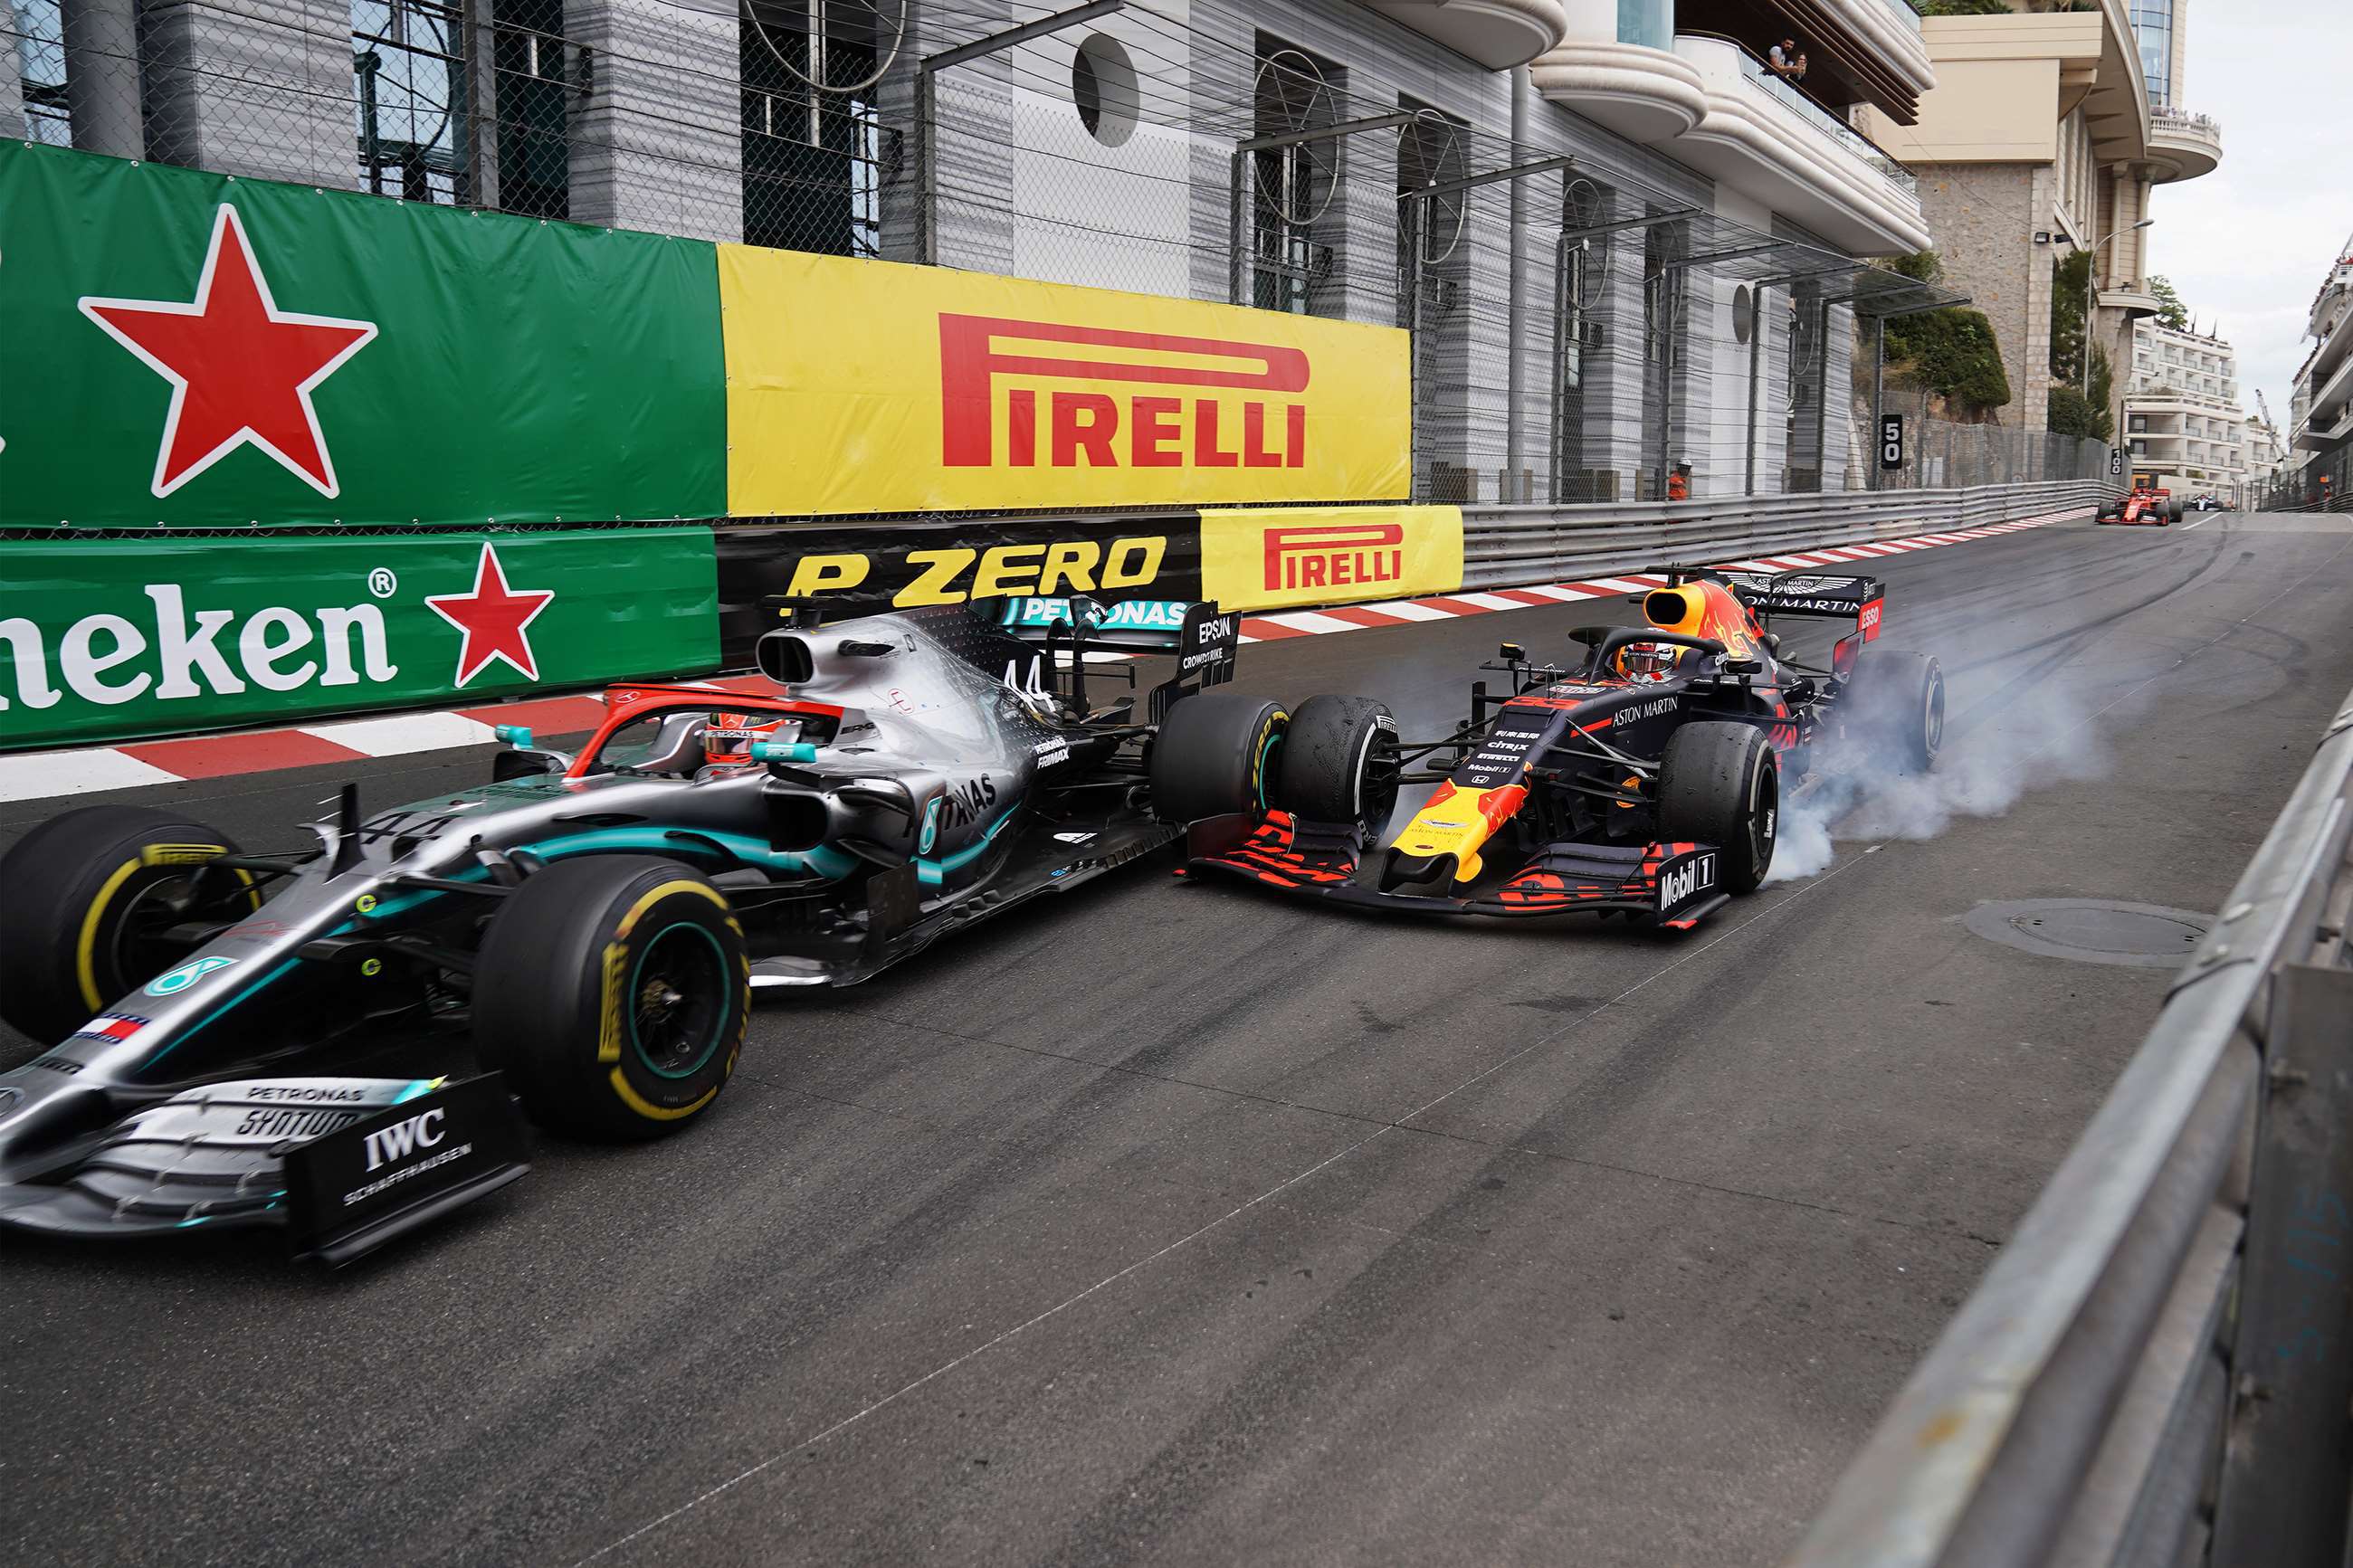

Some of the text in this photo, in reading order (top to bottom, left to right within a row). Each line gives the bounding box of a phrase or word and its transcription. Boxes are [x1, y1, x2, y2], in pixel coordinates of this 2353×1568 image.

[938, 312, 1310, 468] PIRELLI
[1885, 423, 1900, 461] 50
[2112, 450, 2120, 474] 100
[778, 536, 1167, 617] P ZERO
[1263, 524, 1403, 590] PIRELLI
[1198, 616, 1231, 644] EPSON
[1004, 654, 1056, 714] 44
[1613, 696, 1678, 727] ASTON MARTIN
[1037, 746, 1070, 769] FRIMAX
[1468, 764, 1499, 773] Mobil
[1661, 859, 1696, 911] Mobil
[246, 1086, 365, 1102] PETRONAS
[363, 1107, 445, 1173] IWC
[342, 1142, 472, 1207] SCHAFFHAUSEN
